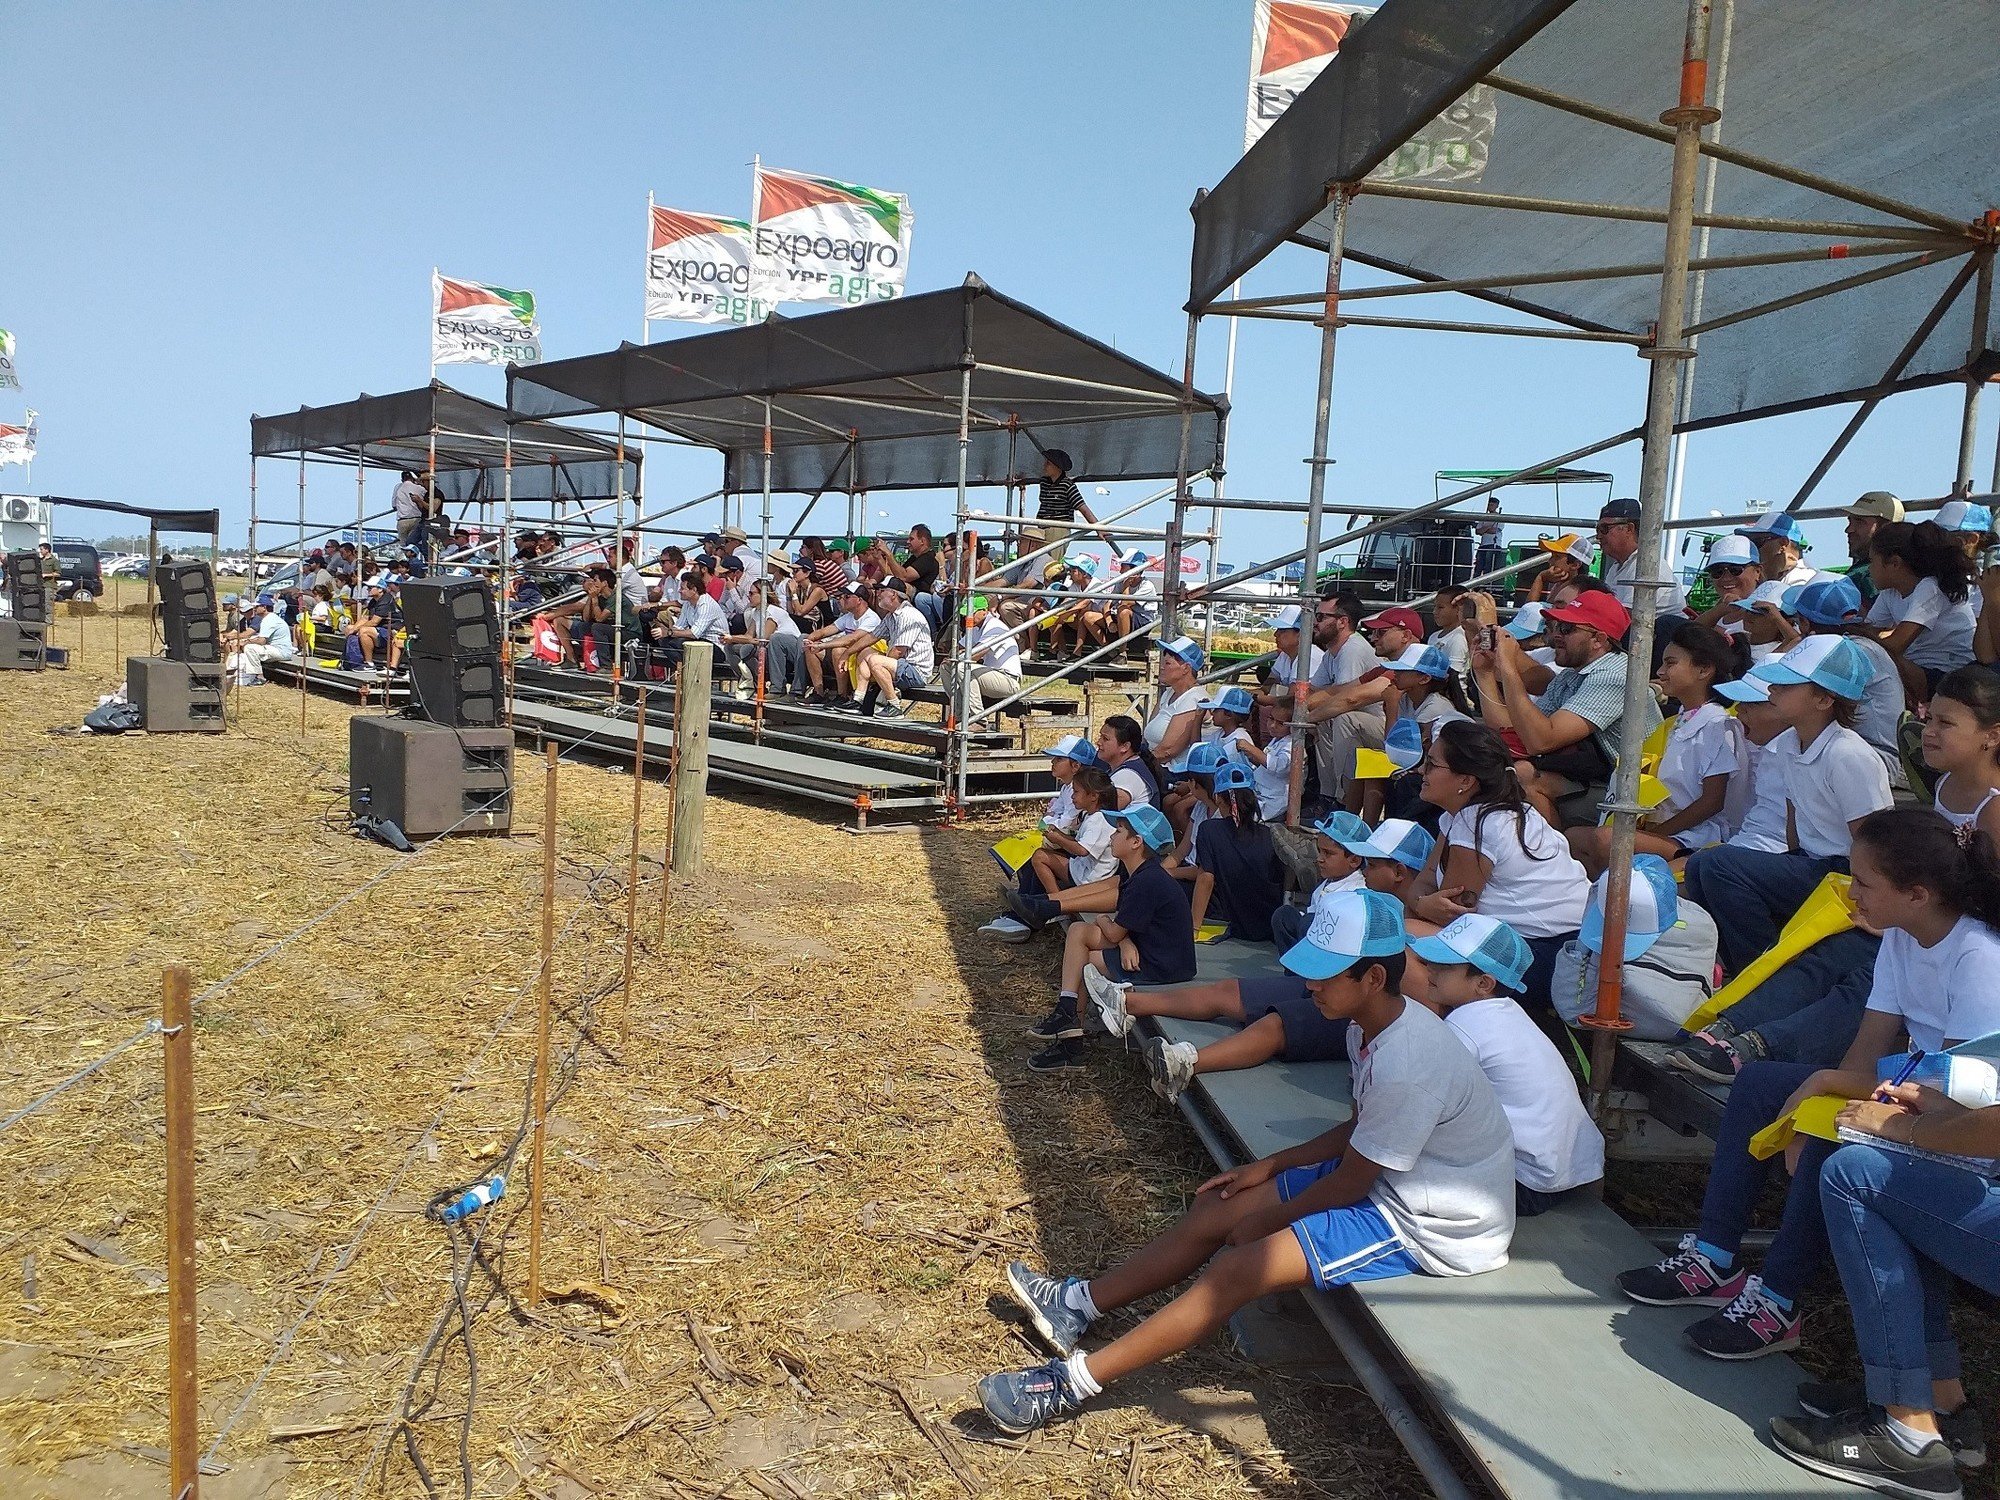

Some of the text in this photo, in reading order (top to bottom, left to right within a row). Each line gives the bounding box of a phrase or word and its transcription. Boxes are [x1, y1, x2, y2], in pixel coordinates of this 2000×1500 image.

[756, 228, 898, 272] Expoagro
[650, 254, 750, 293] Expoag
[786, 268, 828, 283] YPF
[677, 290, 714, 304] YPF
[1676, 1263, 1713, 1296] N
[1748, 1307, 1782, 1344] N
